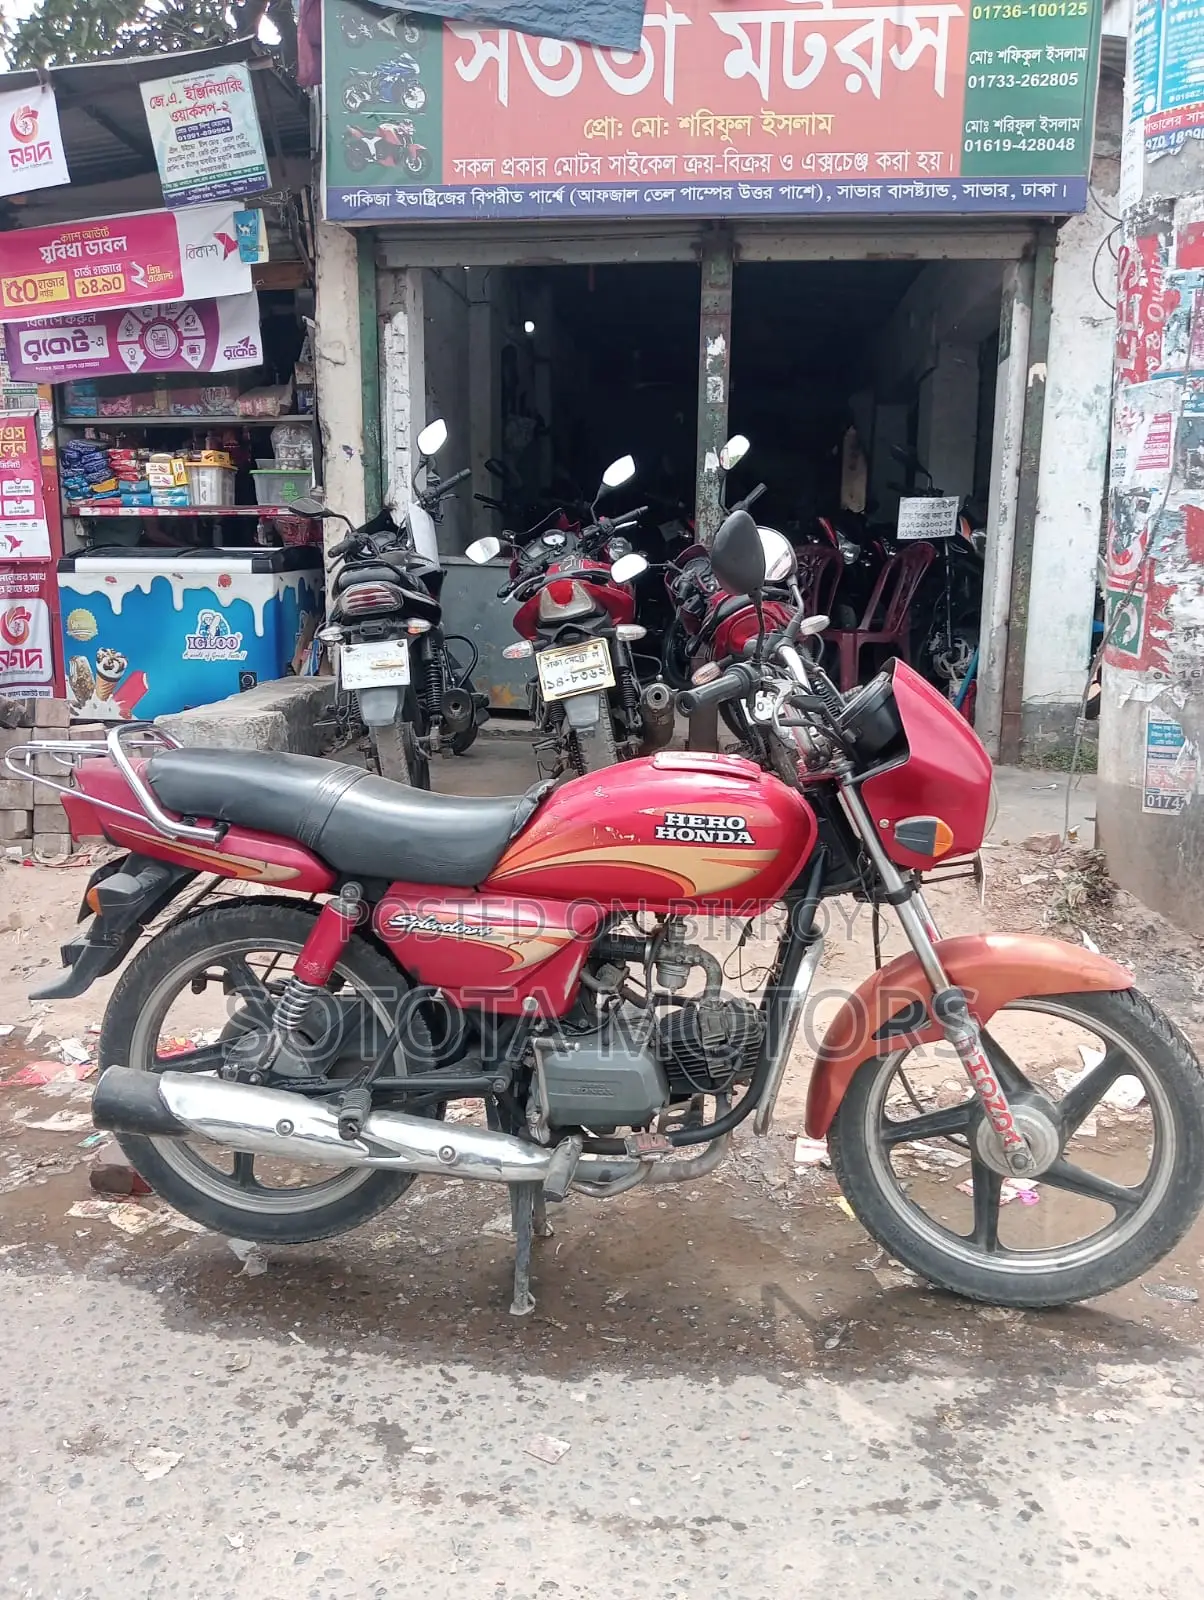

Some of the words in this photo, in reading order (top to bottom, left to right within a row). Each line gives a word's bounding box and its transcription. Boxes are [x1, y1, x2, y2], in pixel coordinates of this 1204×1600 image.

[972, 2, 1087, 20] 01736-100125
[709, 0, 965, 101] মটরস
[970, 49, 993, 65] মোঃ
[996, 45, 1043, 67] শফিকুল
[1045, 44, 1088, 63] ইসলাম
[968, 72, 1078, 88] 01733-262805
[678, 109, 754, 144] শরিফুল
[760, 108, 835, 137] ইসলাম
[965, 119, 990, 133] মোঃ
[993, 115, 1036, 136] শরিফুল
[1039, 114, 1082, 133] ইসলাম
[8, 141, 53, 168] নগদ
[964, 138, 1075, 152] 01619-428048
[453, 158, 497, 178] সকল
[501, 156, 548, 177] প্রকার
[554, 152, 603, 175] মোটর
[608, 149, 679, 176] সাইকেল
[683, 148, 773, 175] ক্রয়-বিক্রয়
[779, 153, 794, 171] ও
[802, 151, 869, 174] এক্সচেঞ্জ
[876, 149, 911, 173] করা
[341, 189, 391, 208] পাকিজা
[471, 187, 524, 205] বিপরীত
[570, 186, 639, 206] (আফজাল
[643, 188, 676, 203] তেল
[680, 185, 734, 201] পাম্পের
[738, 182, 774, 200] উত্তর
[837, 183, 882, 199] সাভার
[963, 183, 1015, 201] সাভার,
[39, 240, 82, 264] সুবিধা
[84, 236, 128, 255] ডাবল
[185, 244, 218, 259] বিকাশ
[73, 265, 93, 278] চার্জ
[94, 263, 122, 275] হাজারে
[129, 260, 148, 288] ২
[37, 277, 65, 289] হাজার
[187, 636, 238, 650] IGLOO
[665, 812, 746, 829] HERO
[655, 826, 755, 844] HONDA
